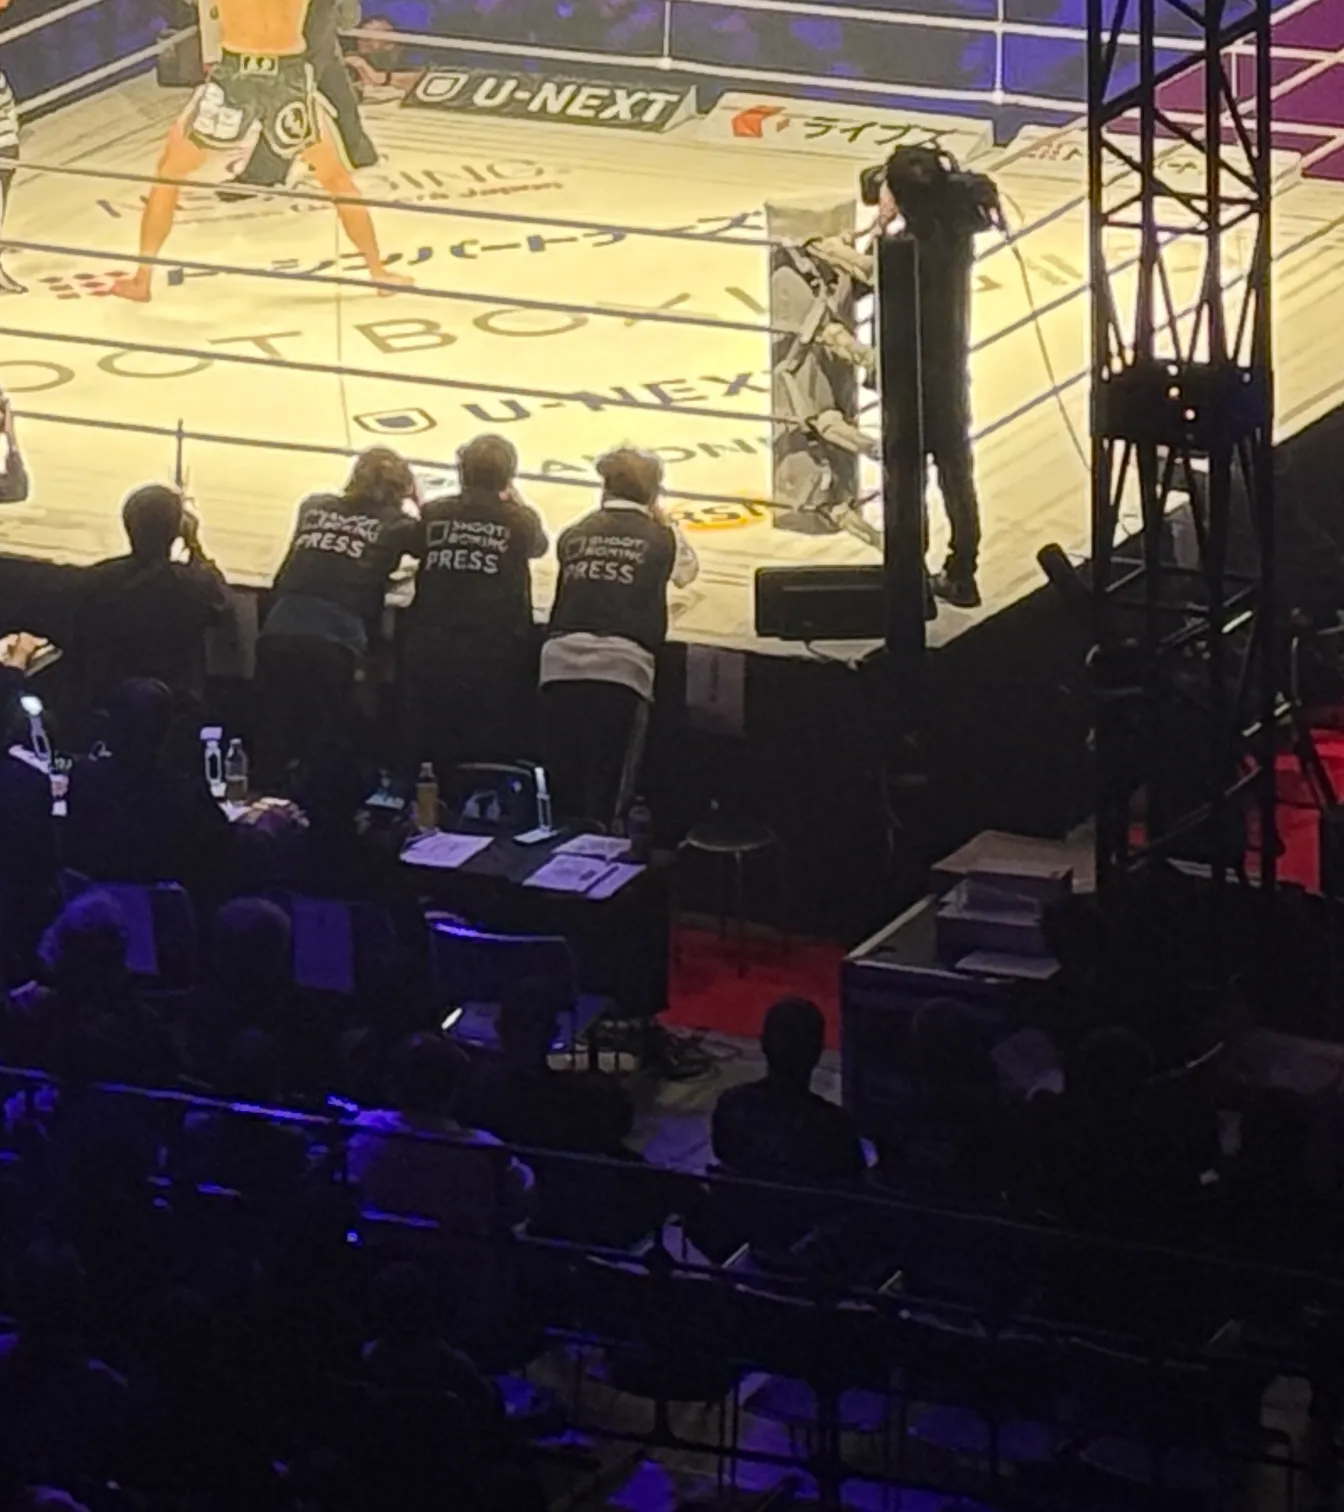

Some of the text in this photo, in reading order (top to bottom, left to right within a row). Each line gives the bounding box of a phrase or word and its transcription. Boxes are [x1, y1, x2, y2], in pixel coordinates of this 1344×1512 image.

[472, 77, 681, 123] U-NEXT
[462, 370, 772, 424] U-NEX
[296, 532, 366, 558] PRESS
[425, 548, 499, 575] PRESS
[563, 560, 635, 585] PRESS
